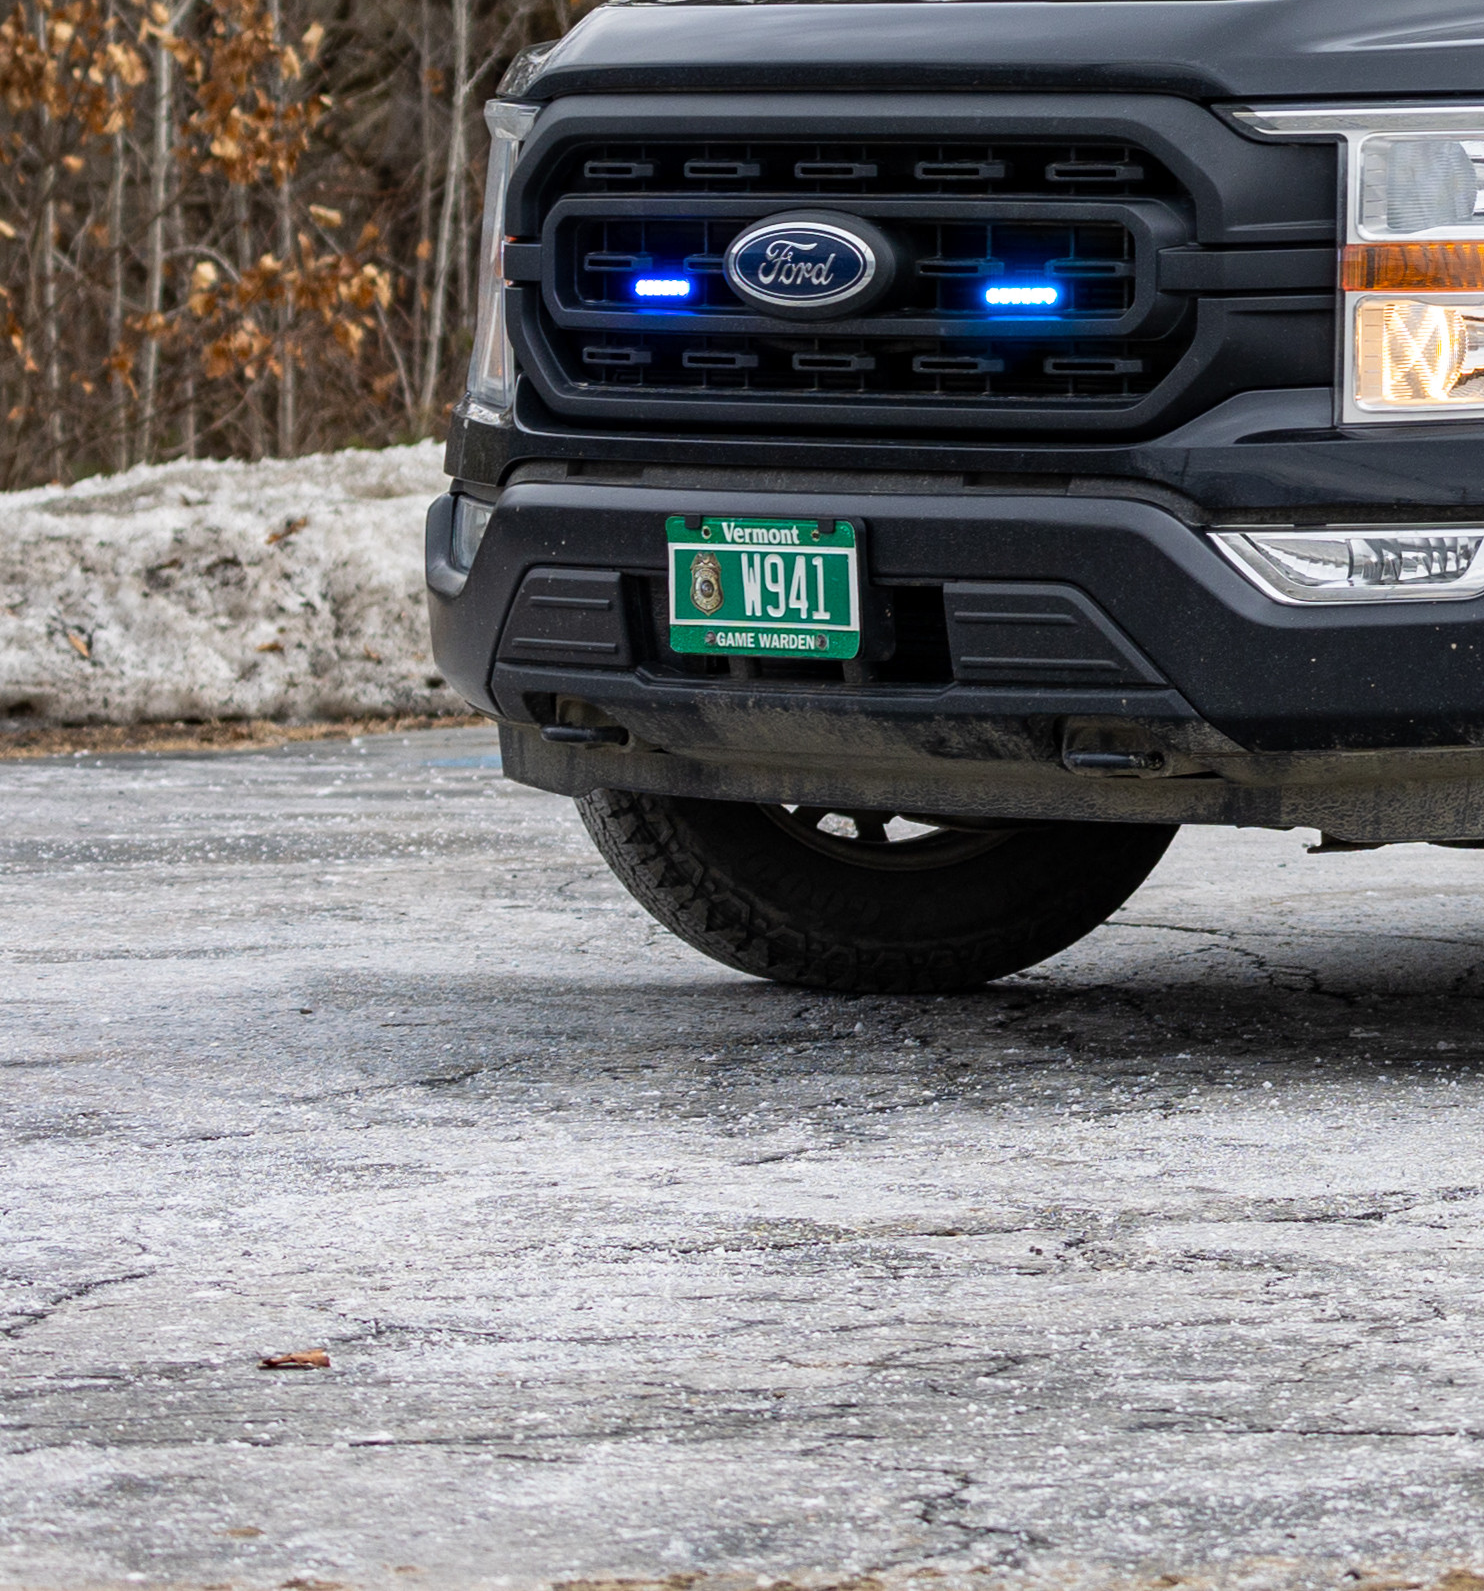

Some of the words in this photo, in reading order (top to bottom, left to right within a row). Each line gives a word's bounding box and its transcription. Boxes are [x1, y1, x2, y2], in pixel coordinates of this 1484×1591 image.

[757, 239, 837, 286] Ford
[721, 521, 801, 545] Vermont
[740, 552, 831, 620] W941
[716, 631, 756, 648] GAME
[758, 633, 816, 650] WARDEN
